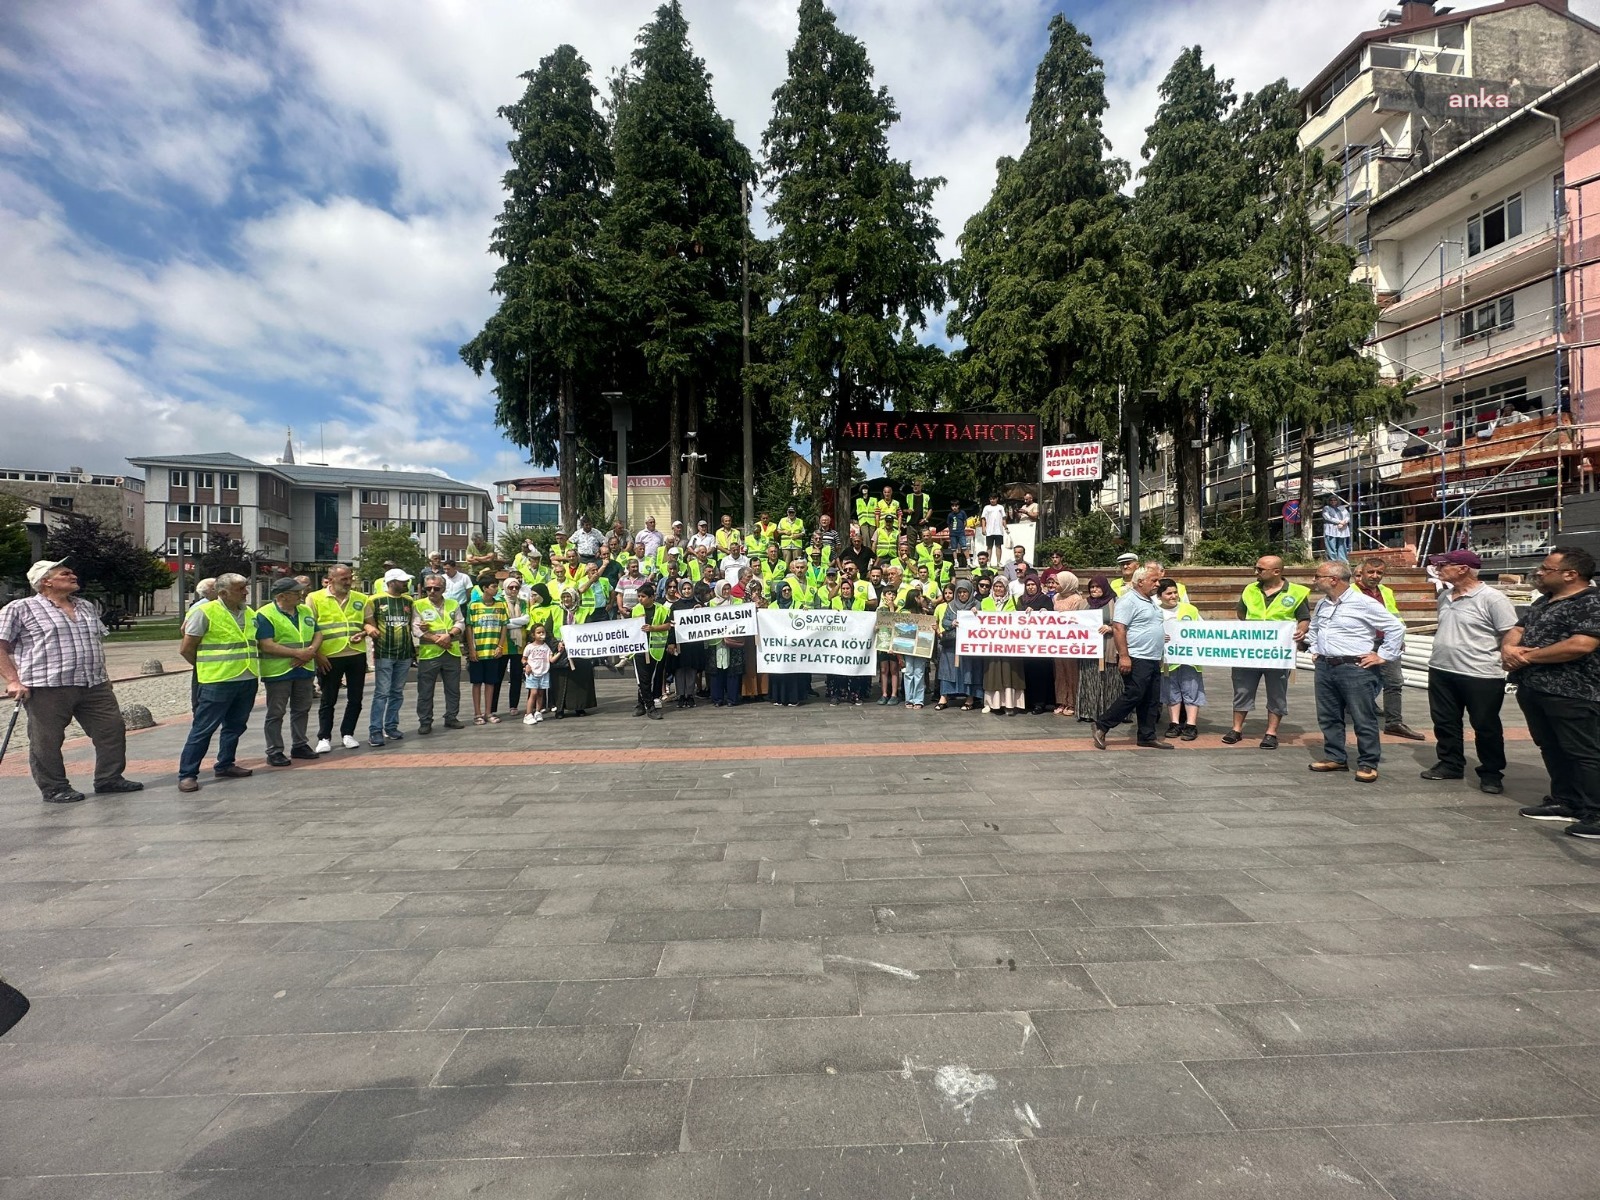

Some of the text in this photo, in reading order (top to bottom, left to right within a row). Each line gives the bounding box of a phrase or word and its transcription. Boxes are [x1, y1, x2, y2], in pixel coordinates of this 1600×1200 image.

[1046, 446, 1099, 458] HANEDAN
[1047, 457, 1097, 467] RESTAURANT
[1063, 465, 1098, 477] GİRİŞ
[627, 478, 666, 487] ALGIDA
[679, 609, 752, 625] ANDIR GALSIN
[978, 614, 1013, 625] YENİ
[576, 629, 630, 643] KÖYLÜ DEĞİL
[968, 628, 1089, 640] KÖYÜNÜ TALAN
[1180, 628, 1278, 640] ORMANLARIMIZI
[610, 643, 646, 654] GİDECEK
[763, 636, 872, 650] YENİ SAYACA KÖYÜ
[961, 642, 1098, 655] ETTİRMEYECEĞİZ
[1167, 644, 1292, 660] SİZE VERMEYECEĞİZ
[764, 653, 870, 665] ÇEVRE PLATFORMU
